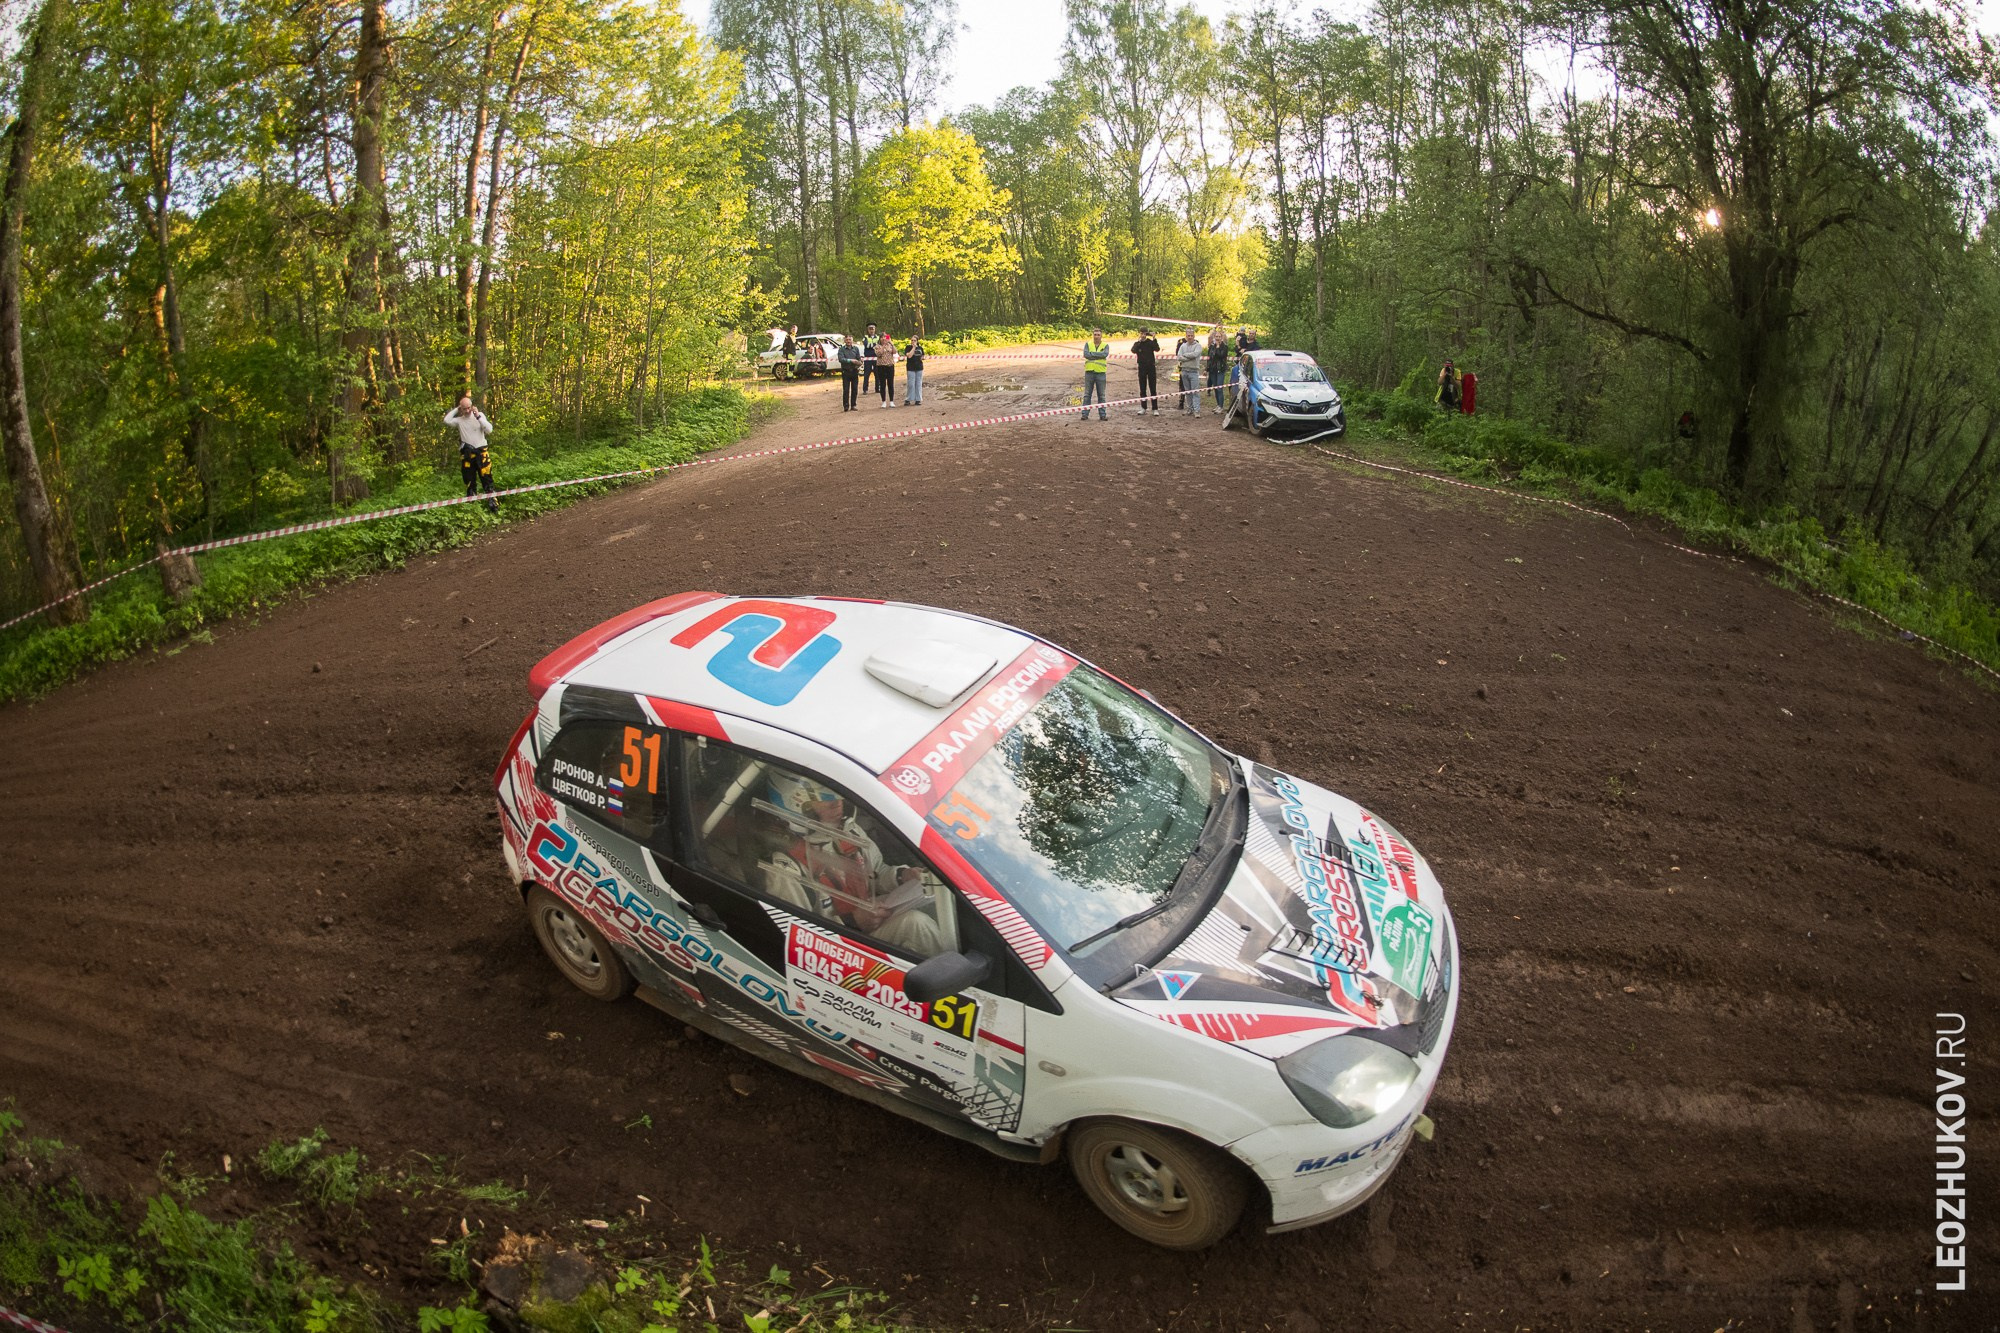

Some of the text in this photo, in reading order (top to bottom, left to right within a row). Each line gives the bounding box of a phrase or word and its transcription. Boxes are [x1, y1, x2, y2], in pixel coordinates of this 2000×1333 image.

[922, 658, 1052, 773] РАЛЛИ РОССИИ
[553, 759, 607, 789] ДРОНОВ А.
[620, 726, 661, 794] 51
[552, 777, 606, 809] ЦВЕТКОВ Р.
[932, 791, 992, 840] 51
[574, 826, 660, 897] crosspargolovospb
[1278, 778, 1339, 956] PARGOLOVO
[563, 869, 696, 971] CROSS
[1321, 853, 1368, 970] CROSS
[1407, 902, 1431, 933] 51
[796, 928, 865, 970] 80 ПОБЕДА!
[1389, 917, 1404, 952] РАЛЛИ
[795, 947, 844, 985] 1945
[821, 997, 882, 1028] РОССИИ
[824, 990, 875, 1017] РАЛЛИ
[866, 979, 923, 1020] 2025
[932, 995, 976, 1038] 51
[879, 1056, 917, 1080] Cross
